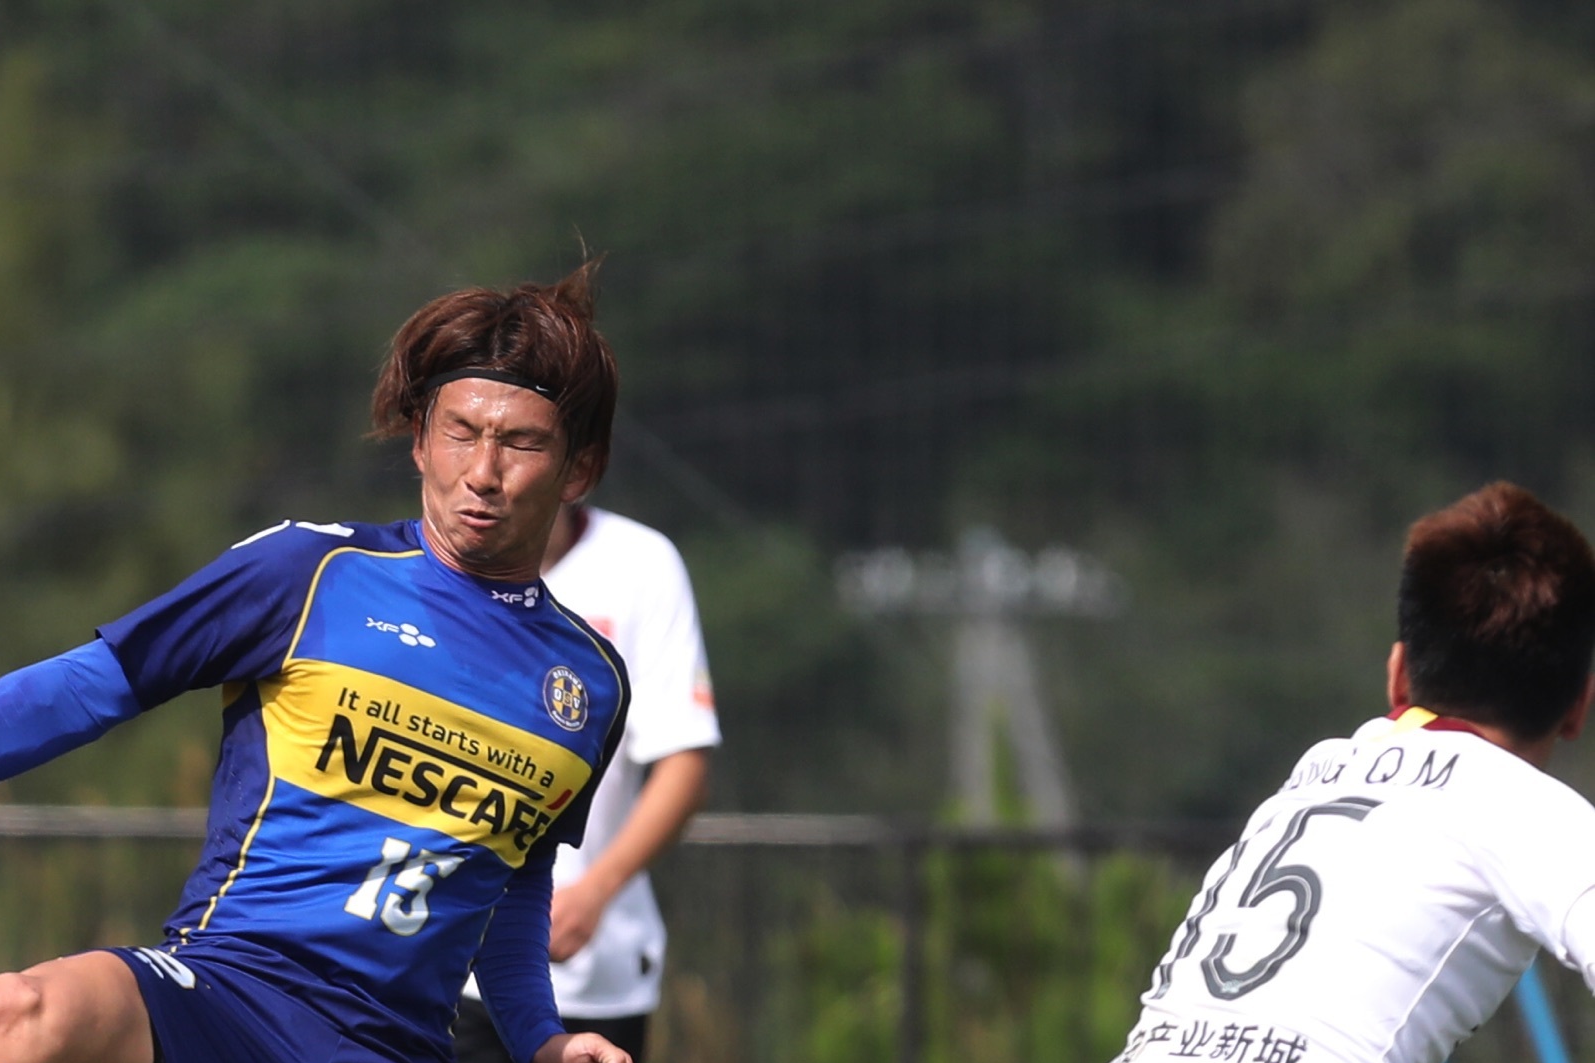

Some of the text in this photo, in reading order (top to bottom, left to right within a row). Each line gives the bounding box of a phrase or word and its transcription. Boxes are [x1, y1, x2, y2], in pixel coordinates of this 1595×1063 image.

[338, 688, 555, 788] It all starts with a
[344, 837, 465, 936] 15
